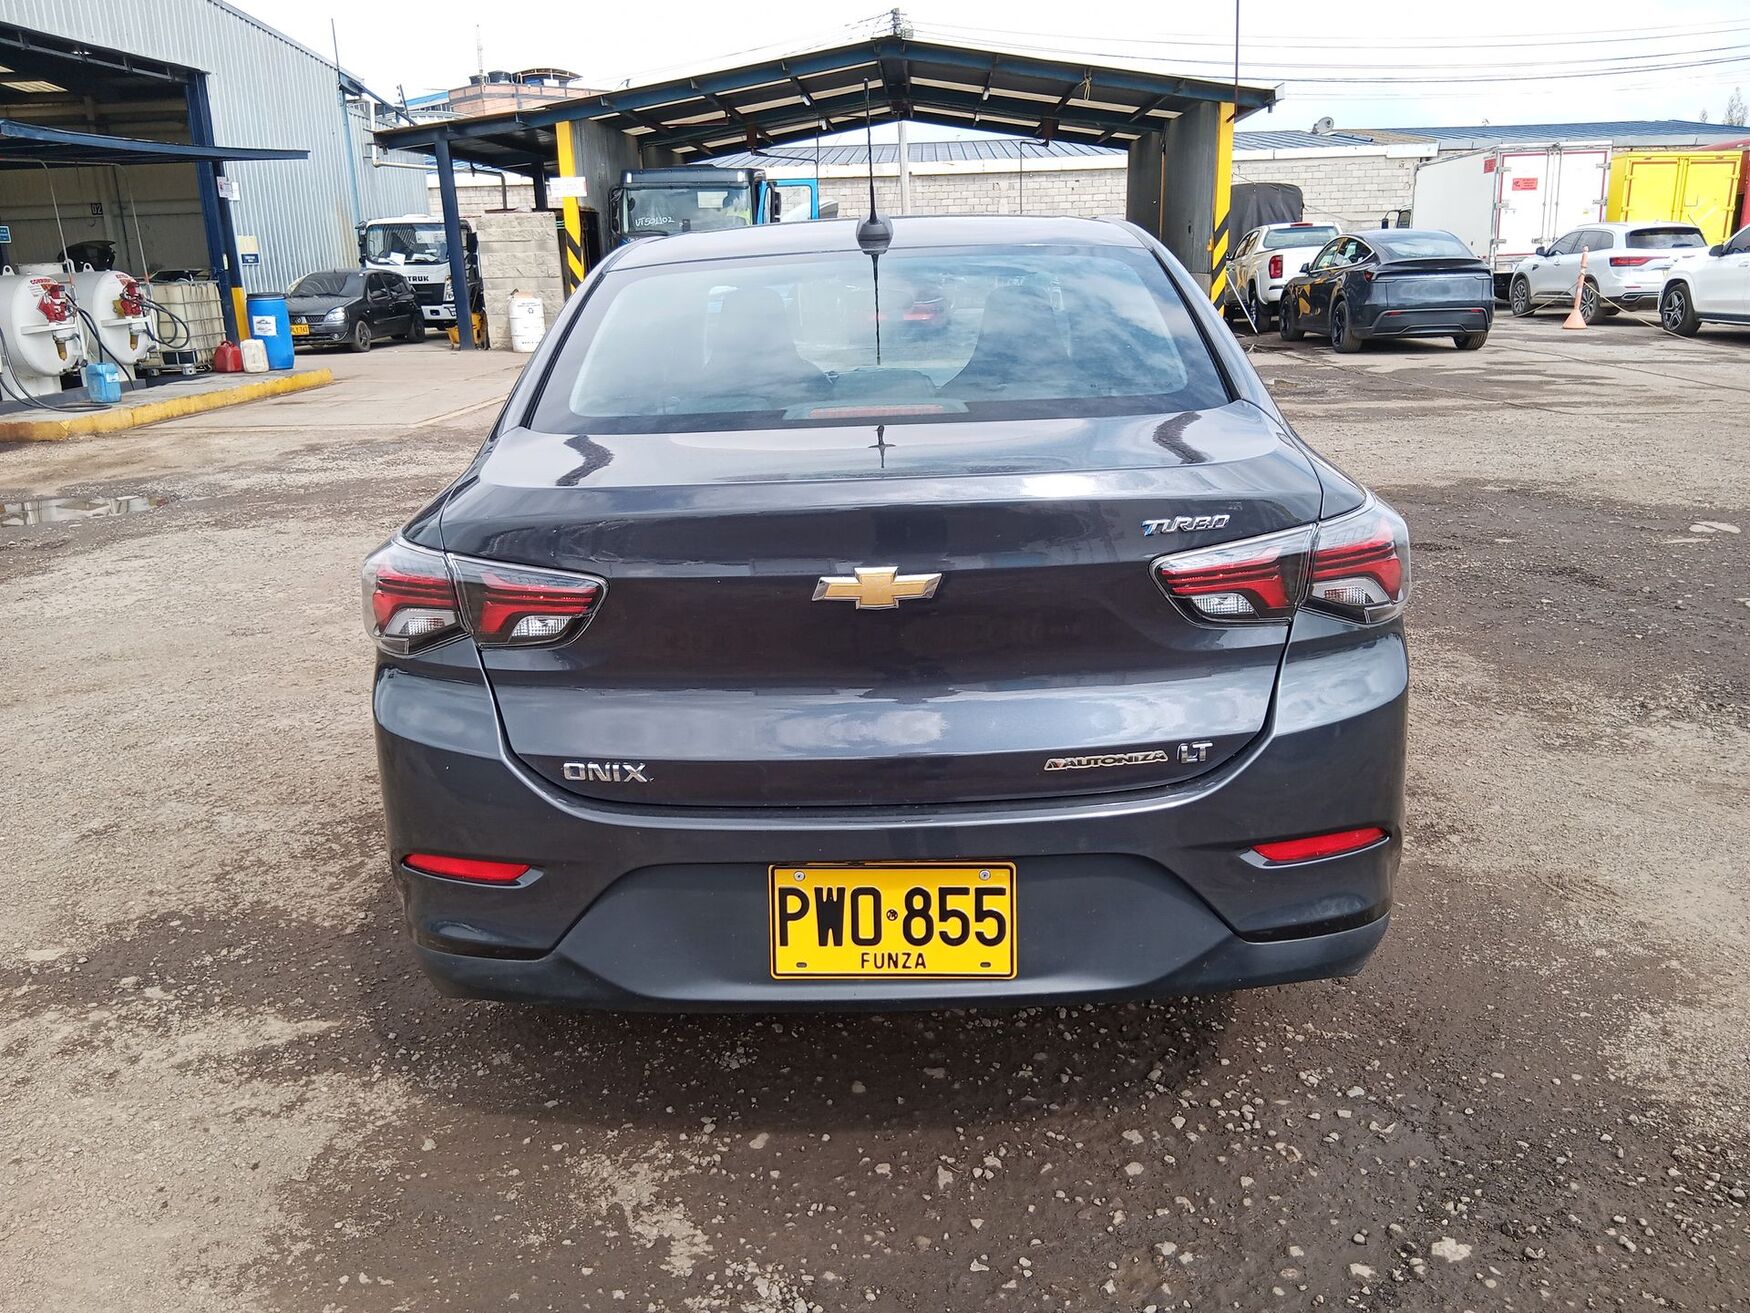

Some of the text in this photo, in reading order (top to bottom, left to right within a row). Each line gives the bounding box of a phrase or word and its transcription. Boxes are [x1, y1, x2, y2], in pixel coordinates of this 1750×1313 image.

[1142, 514, 1230, 537] TURBO
[1062, 742, 1213, 768] AUTONIZA LT
[563, 762, 647, 782] ONIX
[861, 952, 927, 969] FUNZA
